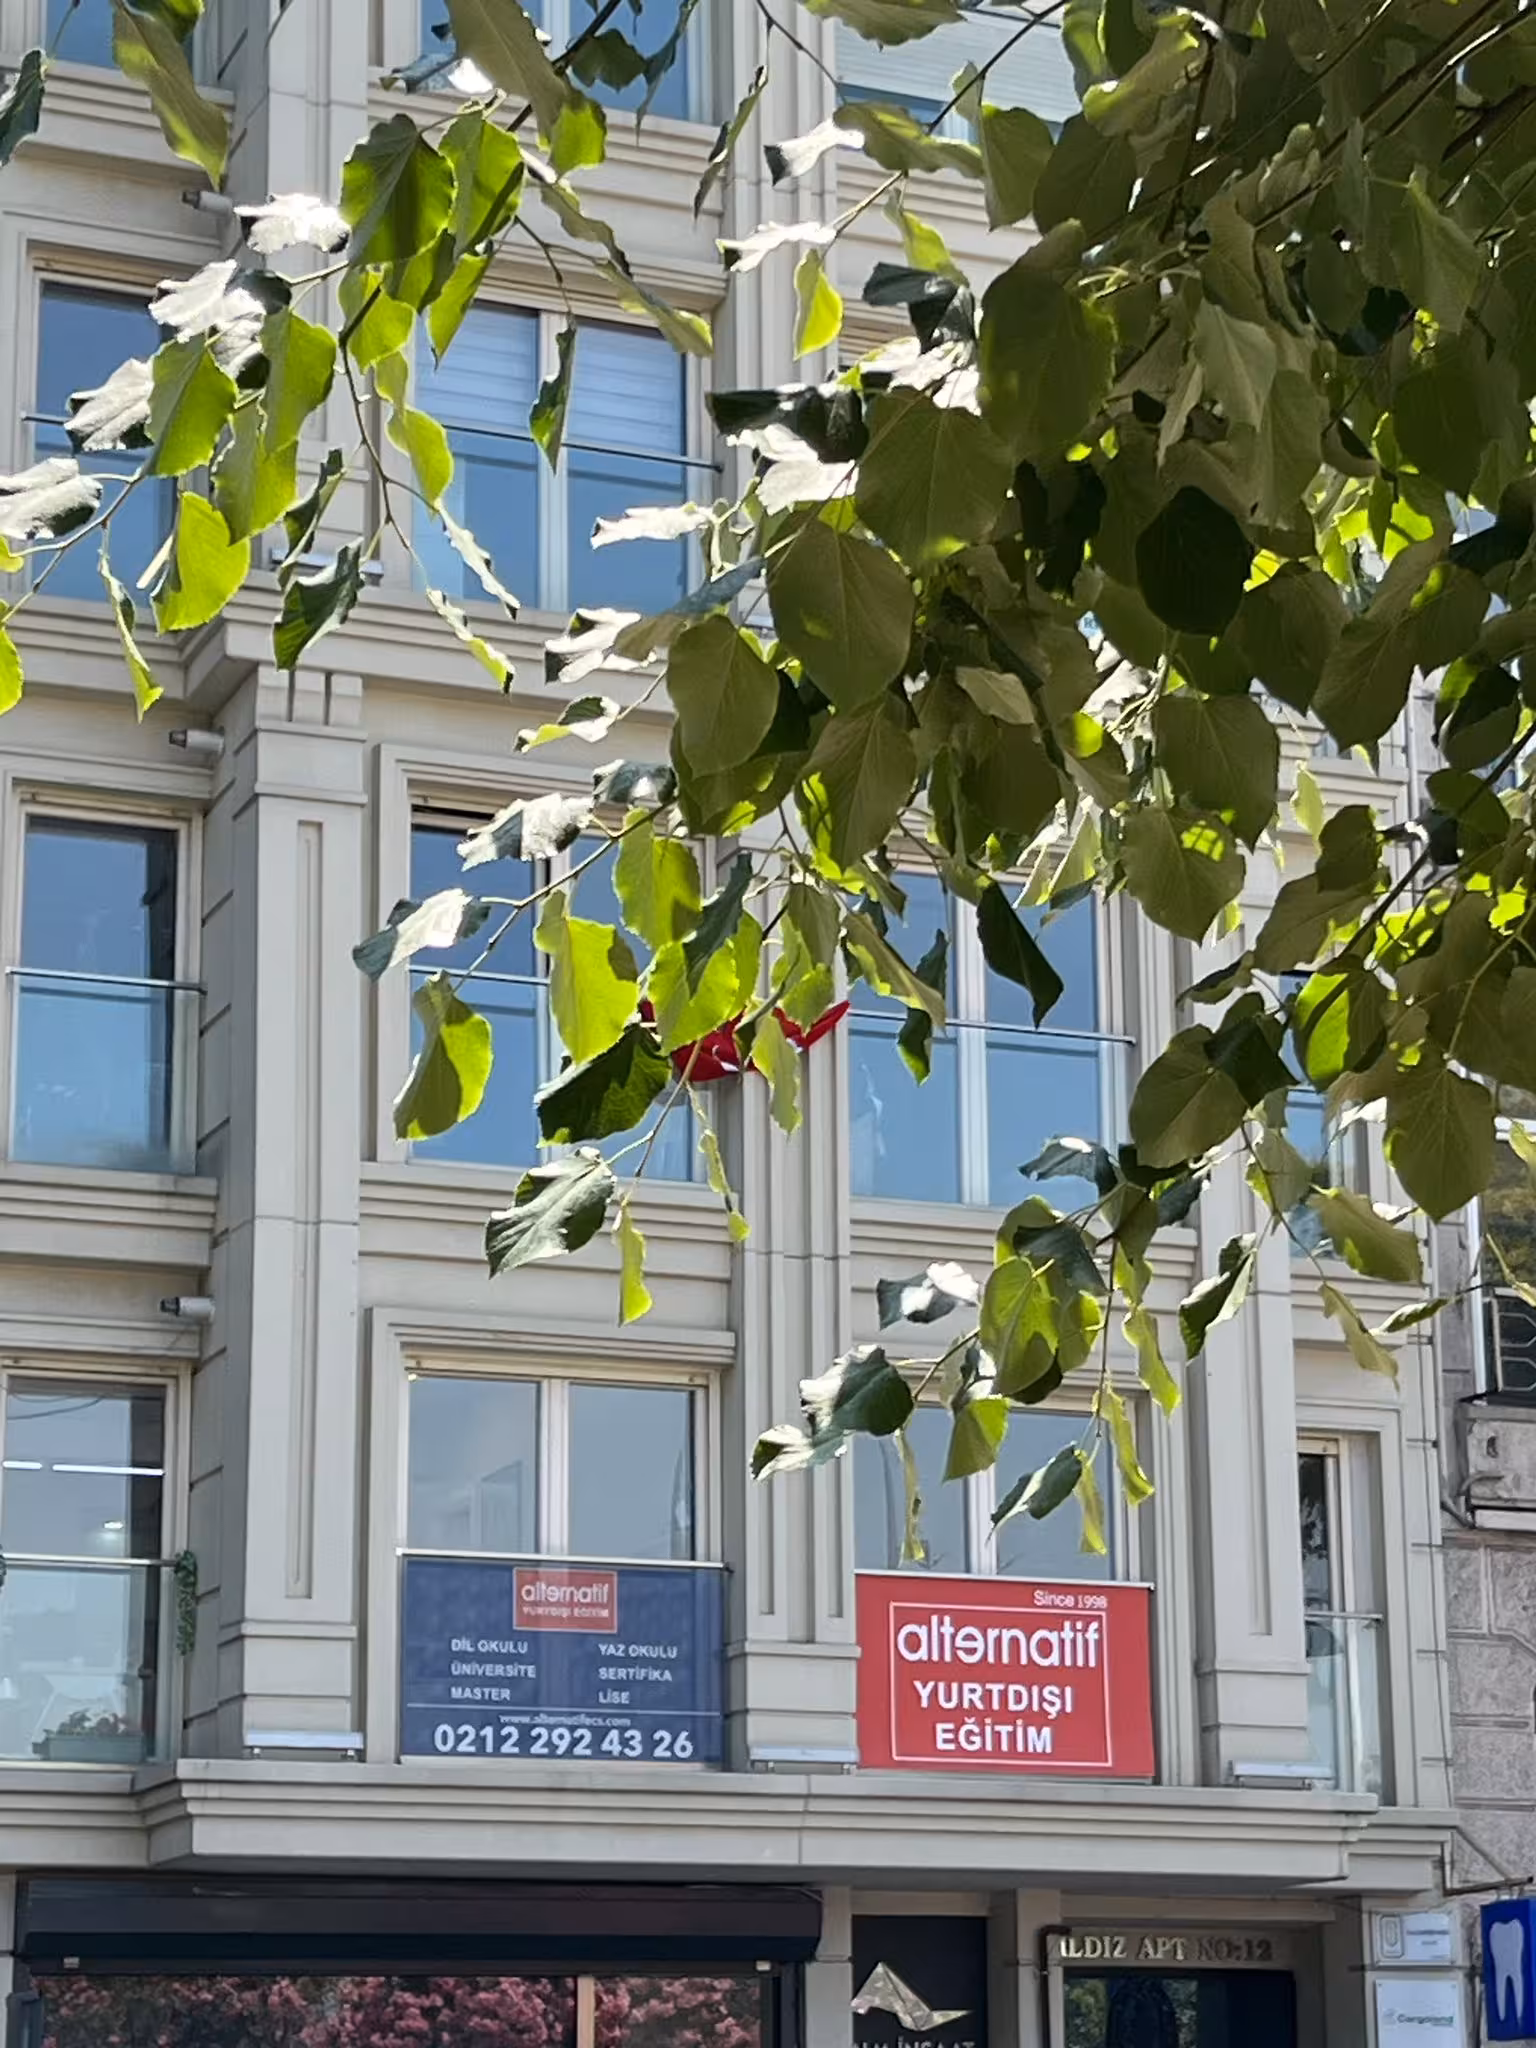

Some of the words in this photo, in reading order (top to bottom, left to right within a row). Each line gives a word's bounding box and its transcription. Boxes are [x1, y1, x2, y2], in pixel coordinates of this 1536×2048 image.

[522, 1582, 610, 1604] alternatif
[1034, 1590, 1074, 1608] Since
[451, 1636, 475, 1652] DİL
[478, 1639, 529, 1654] OKULU
[897, 1615, 1099, 1668] alternatif
[598, 1643, 625, 1657] YAZ
[628, 1644, 678, 1659] OKULU
[451, 1660, 536, 1678] ÜNİVERSİTE
[598, 1665, 673, 1682] SERTİFİKA
[451, 1686, 511, 1701] MASTER
[598, 1688, 630, 1704] LİSE
[914, 1680, 1072, 1719] YURTDIŞI
[434, 1724, 520, 1753] 0212
[529, 1726, 593, 1756] 292
[600, 1729, 643, 1758] 43
[653, 1730, 693, 1759] 26
[935, 1717, 1052, 1754] EĞİTİM
[1059, 1935, 1127, 1959] ILDIZ
[1138, 1936, 1186, 1961] APT
